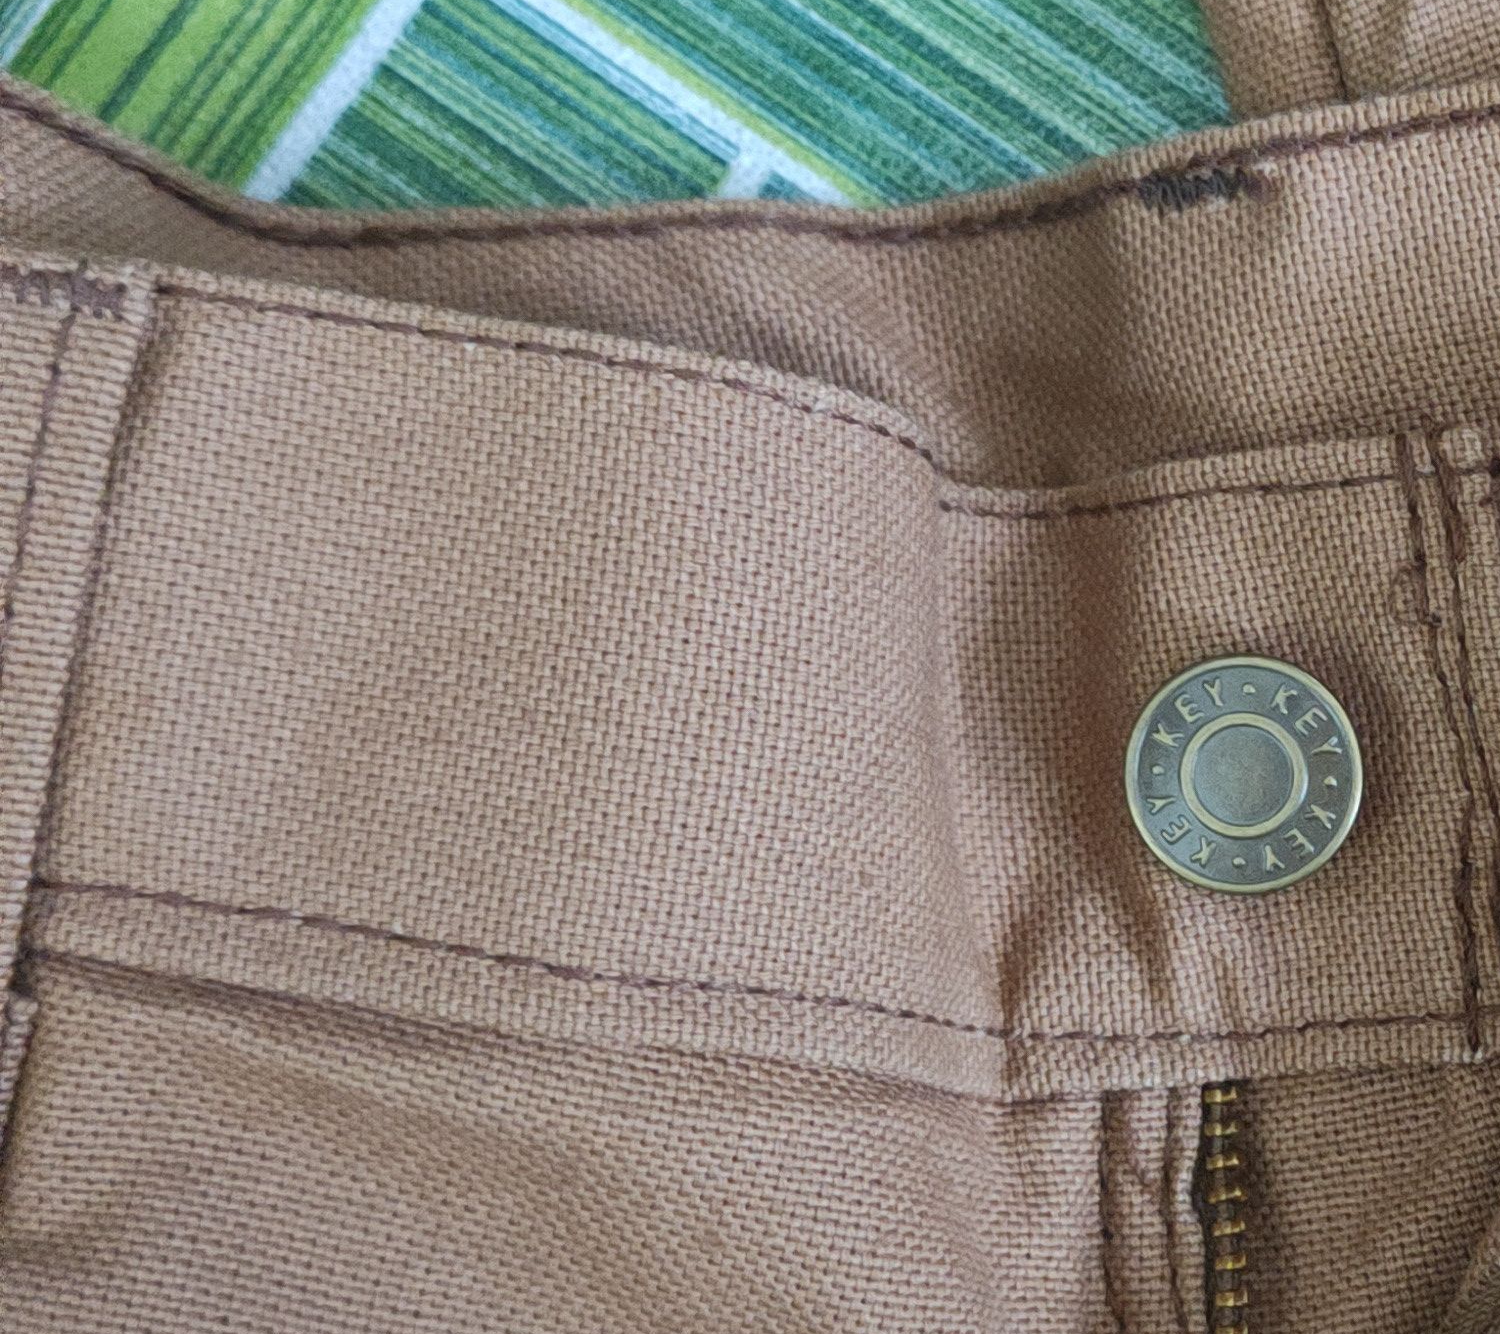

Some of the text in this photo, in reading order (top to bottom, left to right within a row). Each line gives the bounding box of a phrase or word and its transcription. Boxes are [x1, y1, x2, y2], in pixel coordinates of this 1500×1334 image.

[1145, 677, 1343, 872] KEY KEY KEY KEY
